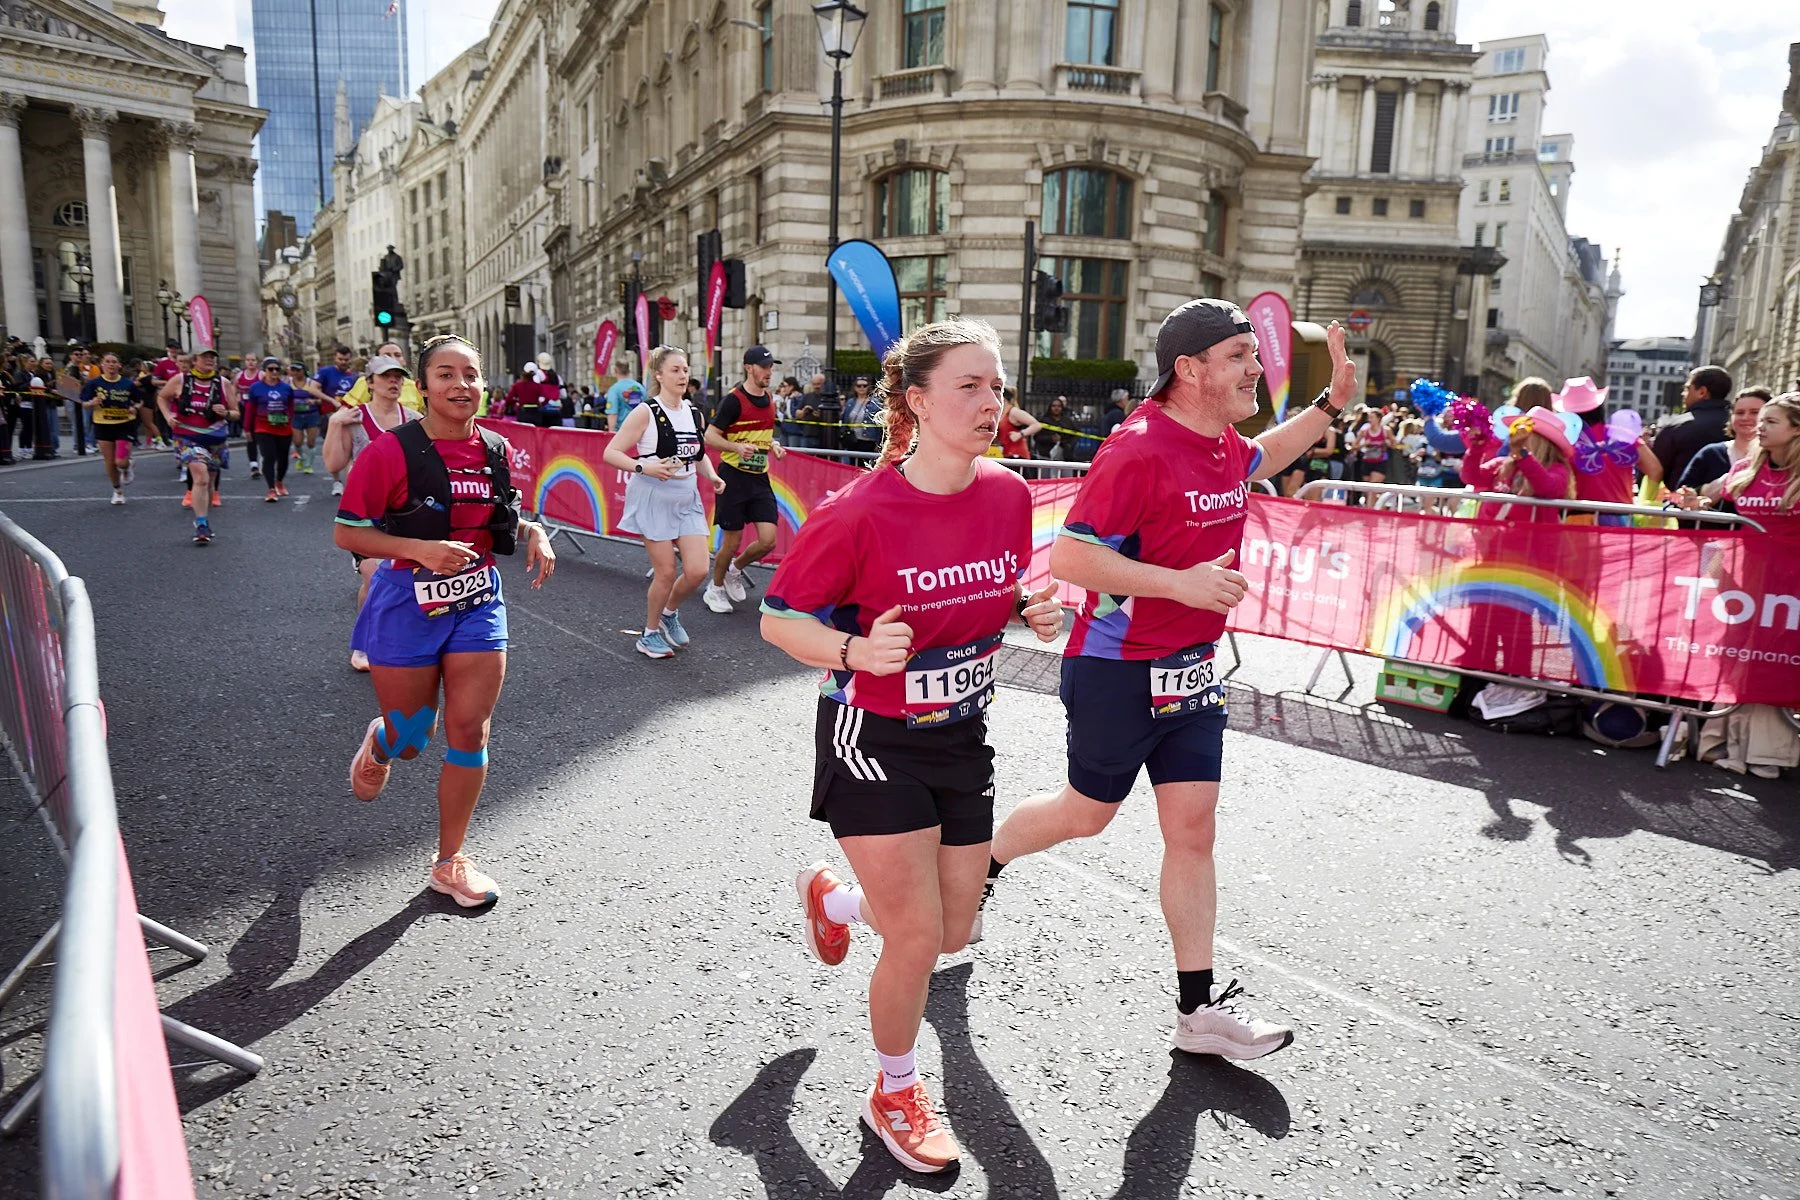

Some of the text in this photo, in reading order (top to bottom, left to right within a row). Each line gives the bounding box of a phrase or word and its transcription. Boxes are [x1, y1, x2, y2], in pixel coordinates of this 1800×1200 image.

[897, 550, 1018, 594] Tommy's
[1239, 538, 1353, 583] my's
[422, 570, 487, 601] 10923
[902, 604, 919, 613] The
[921, 595, 967, 612] pregnancy
[968, 591, 983, 601] and
[984, 589, 1002, 599] baby
[946, 645, 977, 660] CHLOE
[1665, 636, 1700, 654] The
[915, 655, 994, 700] 11964
[1158, 661, 1214, 693] 11963
